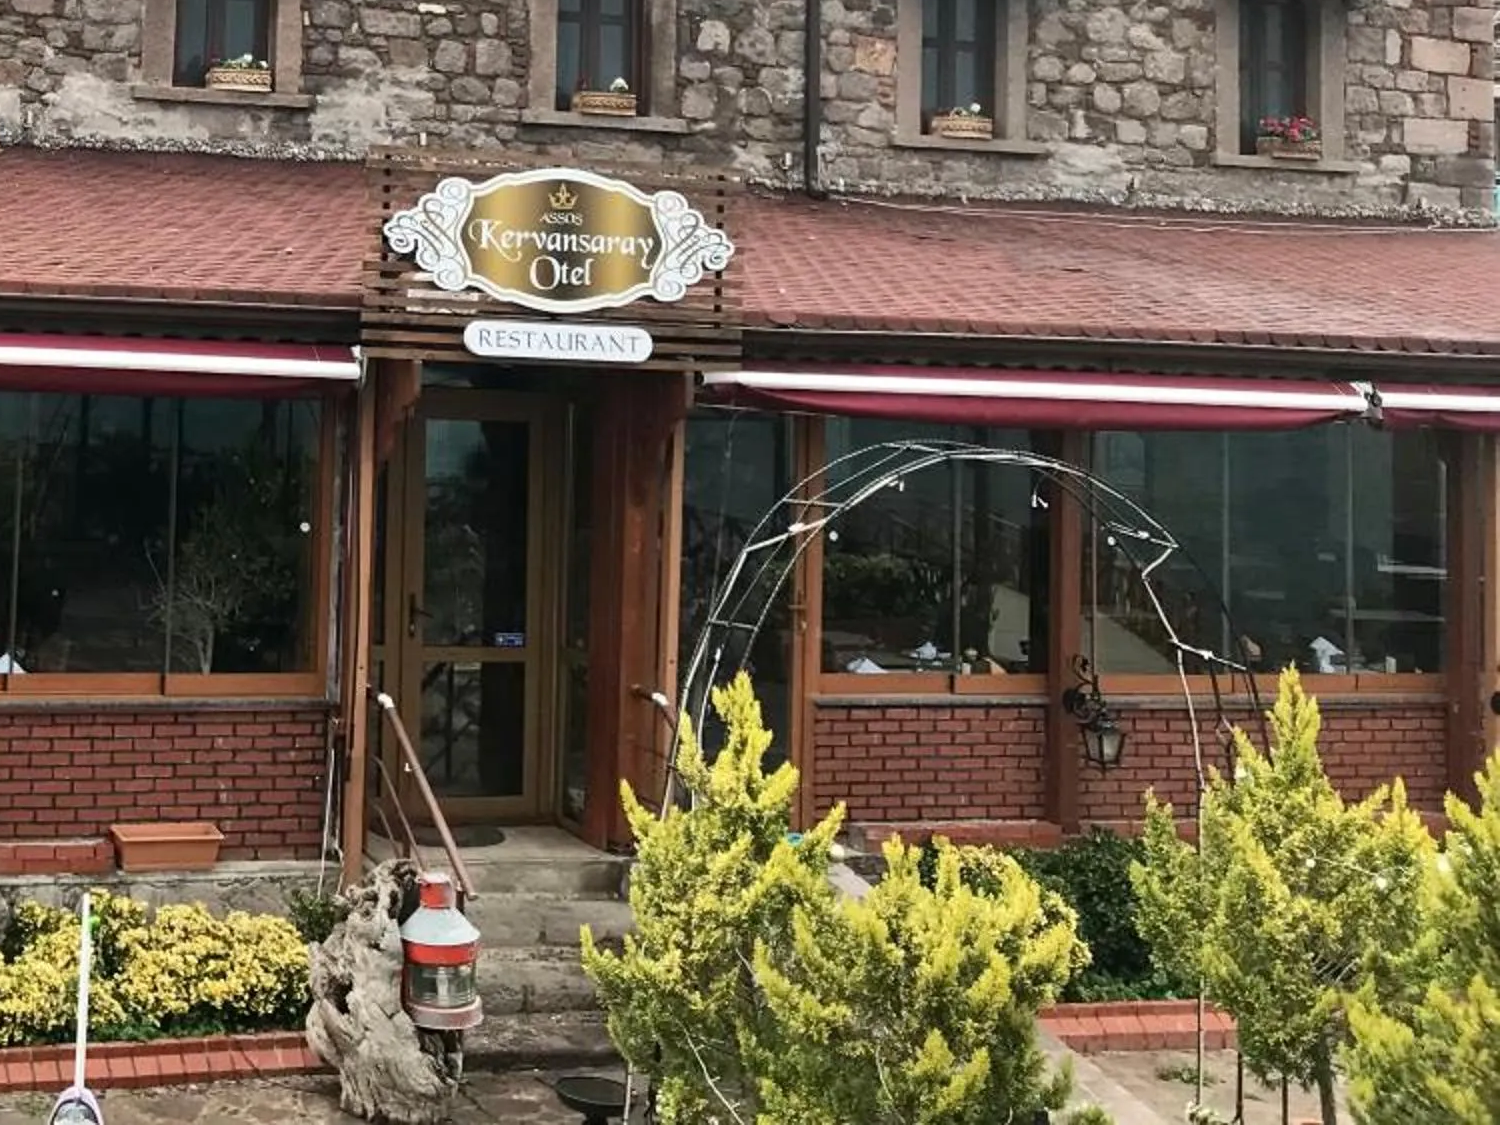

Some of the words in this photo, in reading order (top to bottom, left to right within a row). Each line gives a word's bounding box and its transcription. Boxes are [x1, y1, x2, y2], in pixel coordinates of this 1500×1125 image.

[468, 218, 654, 269] Kervansaray
[530, 255, 595, 290] Otel
[478, 328, 642, 354] RESTAURANT
